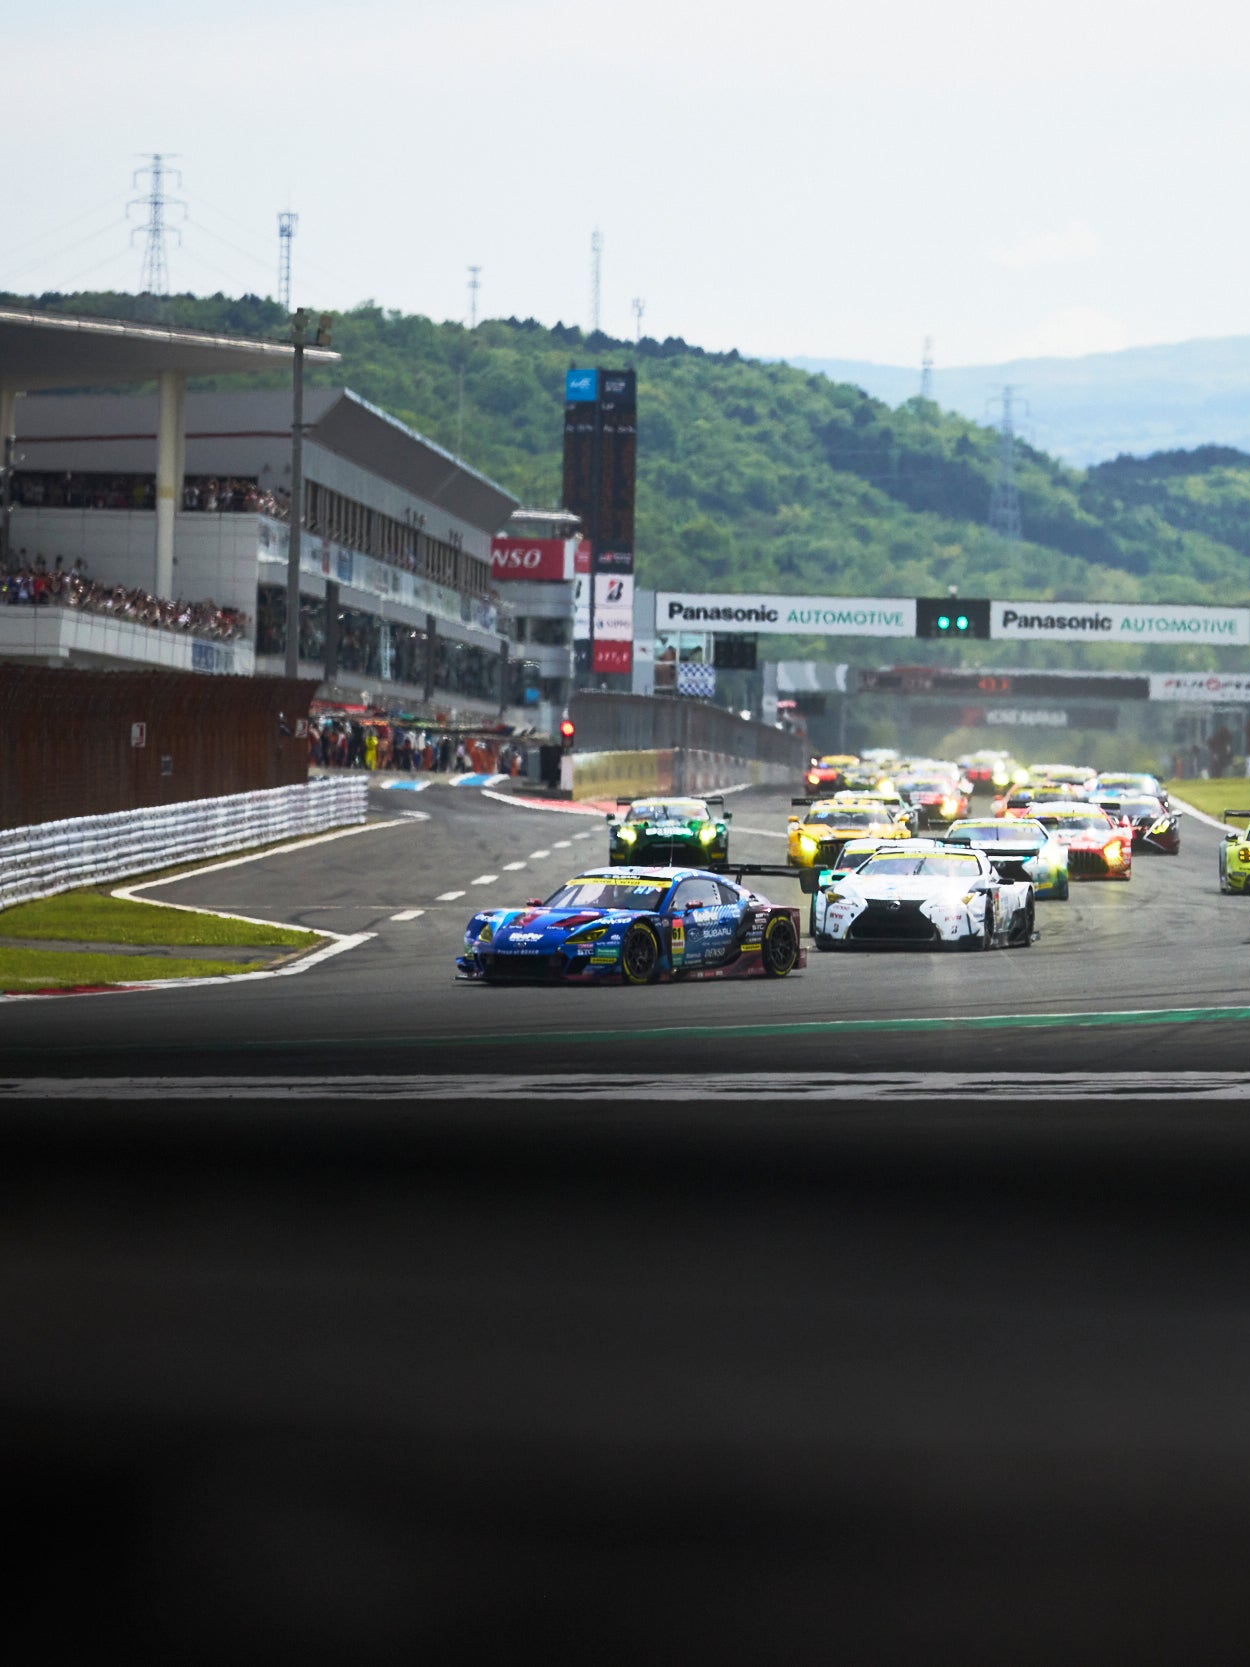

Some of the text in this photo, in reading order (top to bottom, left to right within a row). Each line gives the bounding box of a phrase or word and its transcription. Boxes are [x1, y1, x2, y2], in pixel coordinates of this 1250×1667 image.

[668, 602, 904, 627] Panasonic AUTOMOTIVE
[1002, 610, 1238, 635] Panasonic AUTOMOTIVE
[672, 929, 681, 940] 61
[703, 927, 732, 938] SUBARU
